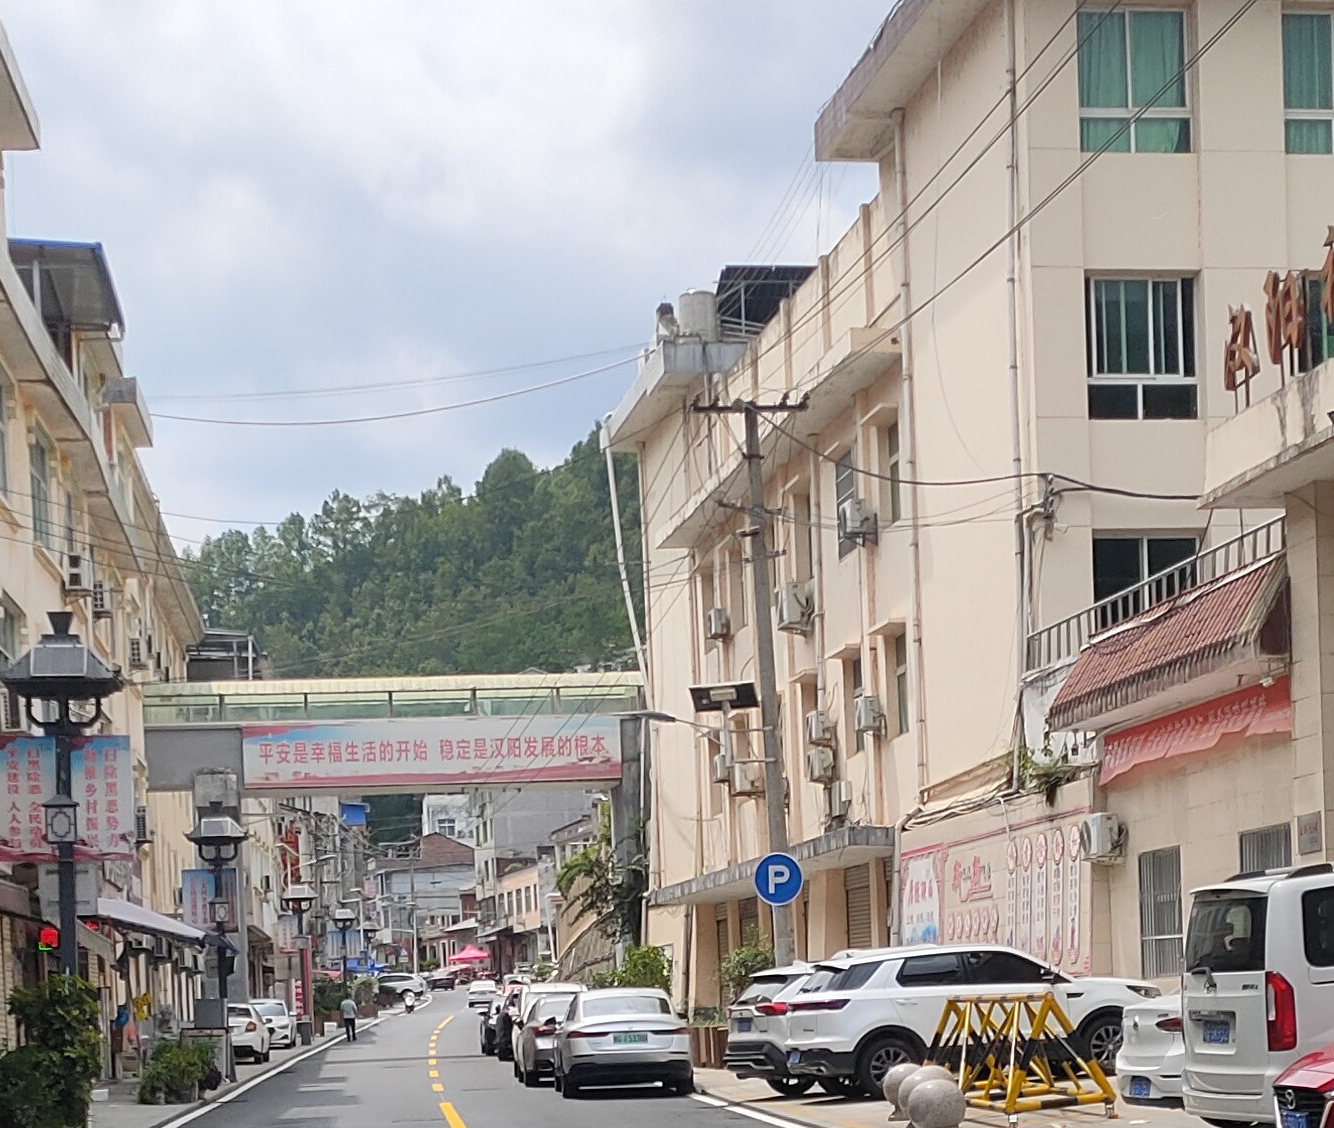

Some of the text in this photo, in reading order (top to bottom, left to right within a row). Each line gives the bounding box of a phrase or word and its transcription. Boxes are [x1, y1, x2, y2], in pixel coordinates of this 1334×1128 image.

[258, 734, 605, 764] 平安是幸福生活的开始 稳定是汉阳发展的根本
[768, 865, 790, 894] P
